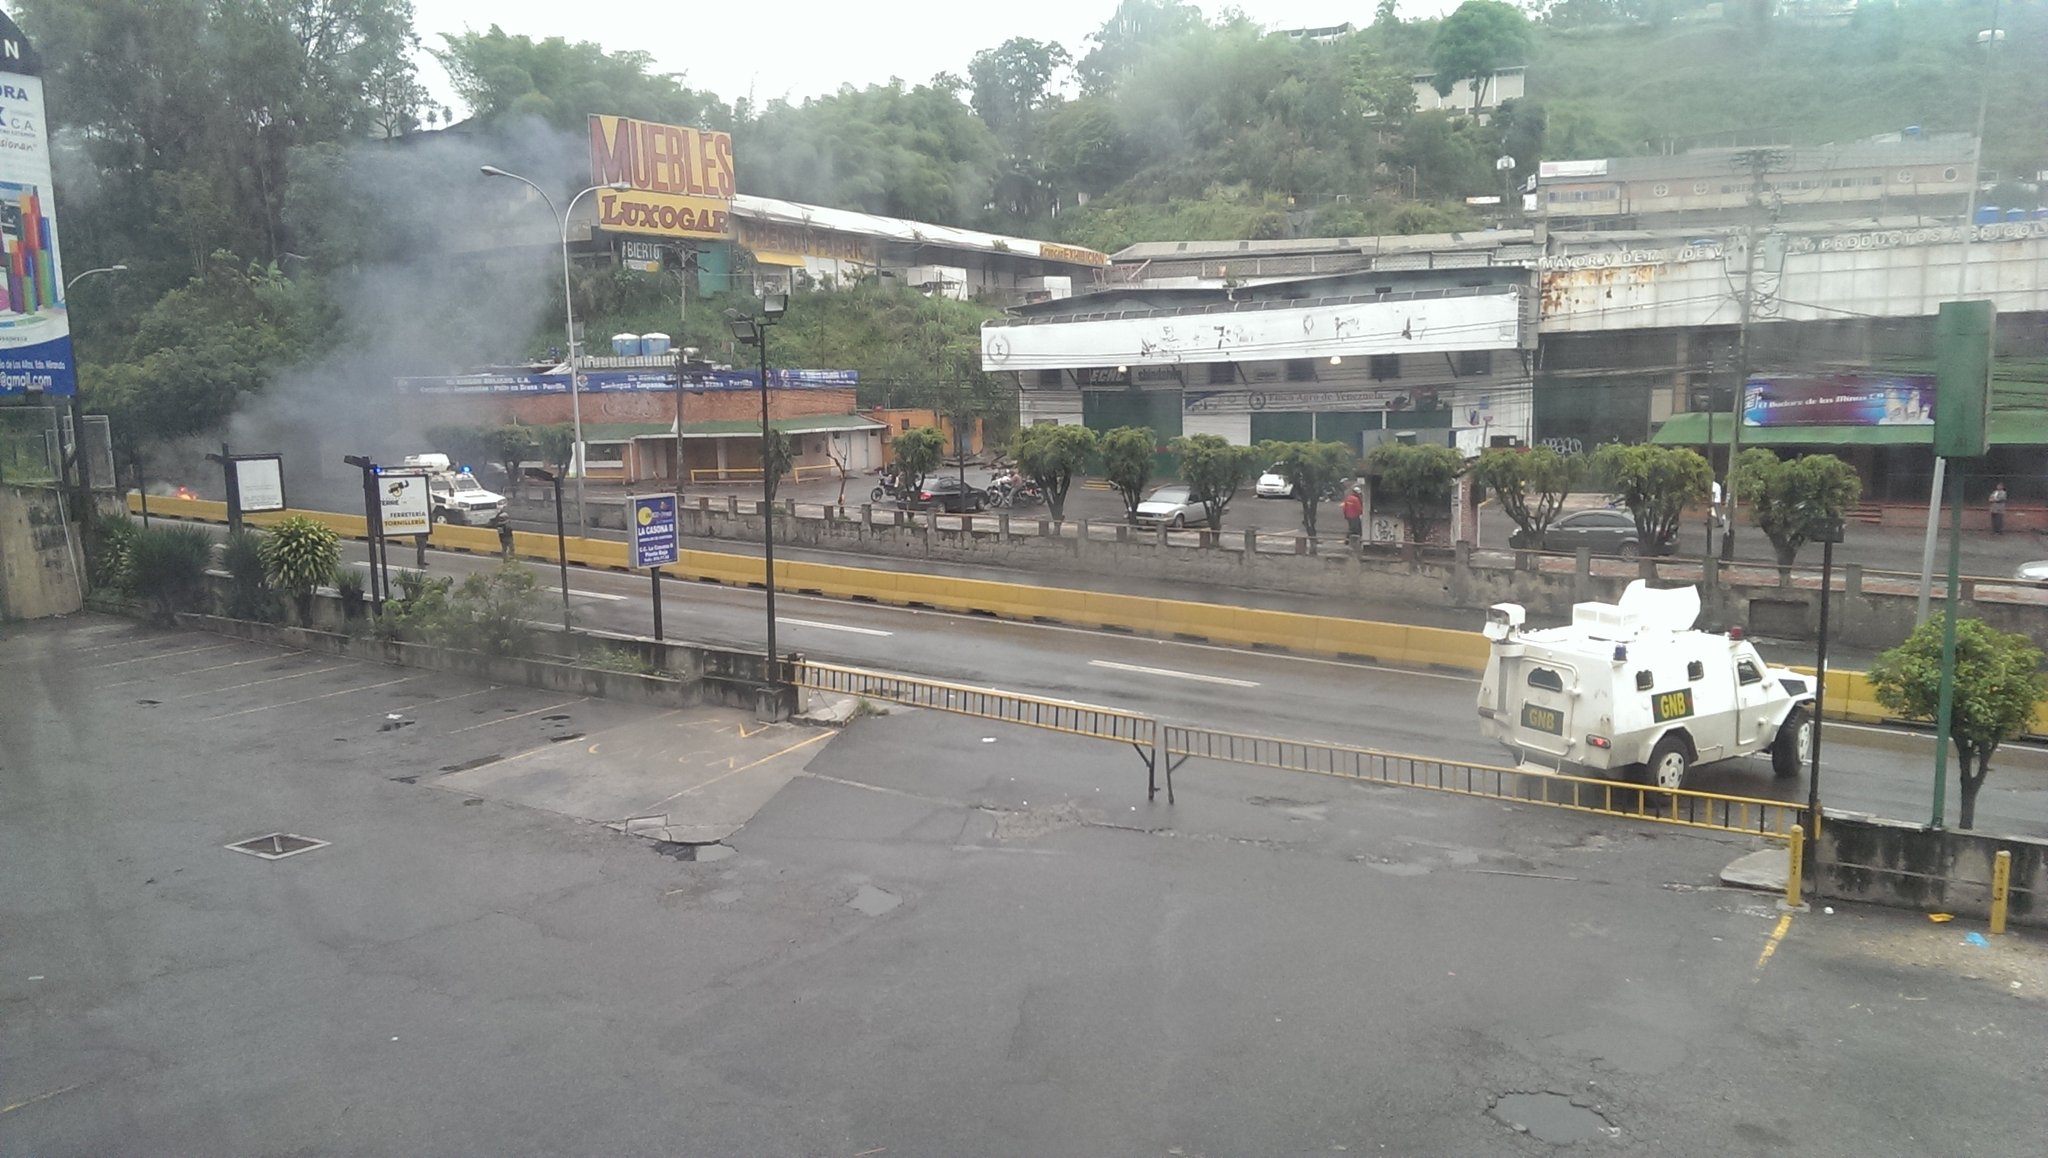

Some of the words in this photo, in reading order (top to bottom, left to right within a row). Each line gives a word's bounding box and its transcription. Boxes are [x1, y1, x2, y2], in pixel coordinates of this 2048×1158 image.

[4, 39, 20, 60] N
[0, 84, 29, 102] RA
[590, 114, 736, 198] MUEBLES
[601, 195, 729, 234] LUXOGAR
[1821, 230, 1941, 249] PRODUCTOS
[1950, 223, 2048, 243] AGRICOL
[1542, 255, 1597, 269] MAYOR
[1604, 254, 1617, 264] Y
[1684, 248, 1706, 259] DE
[0, 371, 52, 390] @gmail.com
[638, 527, 646, 536] LA
[646, 524, 668, 535] CASONA
[1660, 693, 1687, 719] GNB
[1528, 708, 1555, 730] GNB
